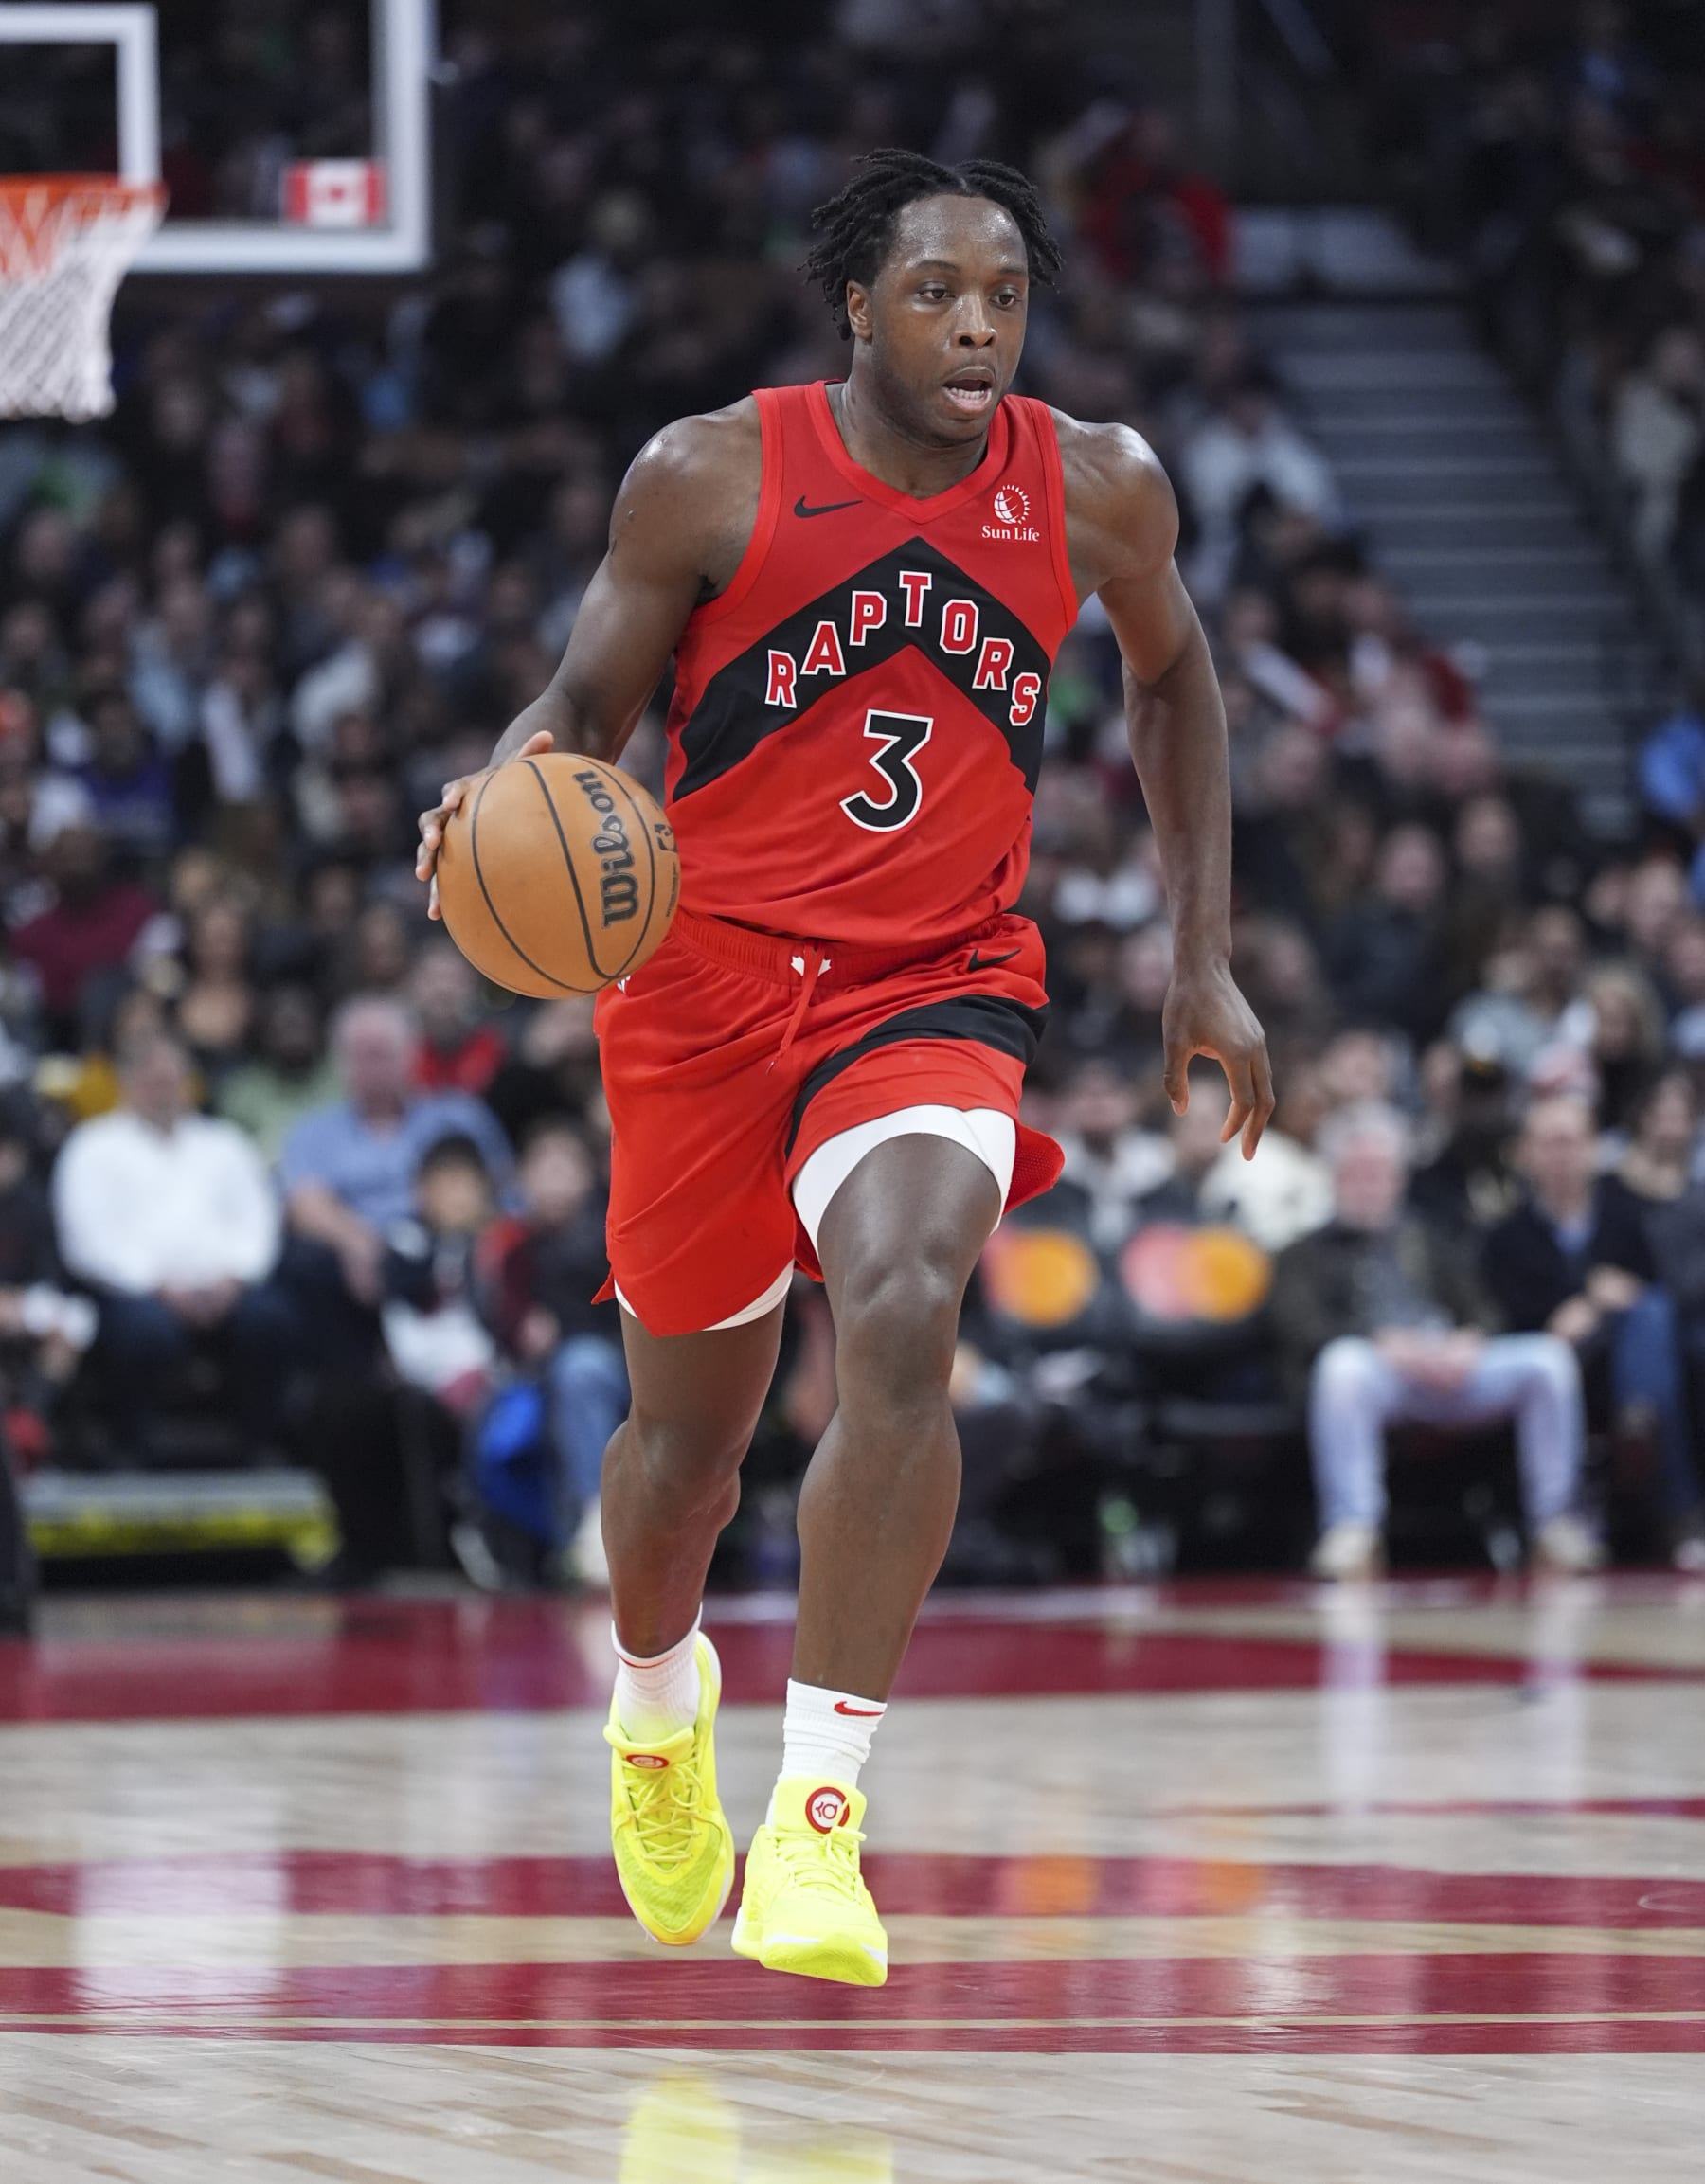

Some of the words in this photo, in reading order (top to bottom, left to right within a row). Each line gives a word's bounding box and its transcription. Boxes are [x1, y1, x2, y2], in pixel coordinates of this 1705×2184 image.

[981, 525, 1011, 540] Sun
[1014, 527, 1040, 542] Life
[765, 570, 1041, 726] RAPTORS
[839, 708, 934, 832] 3
[573, 769, 639, 930] Wilson
